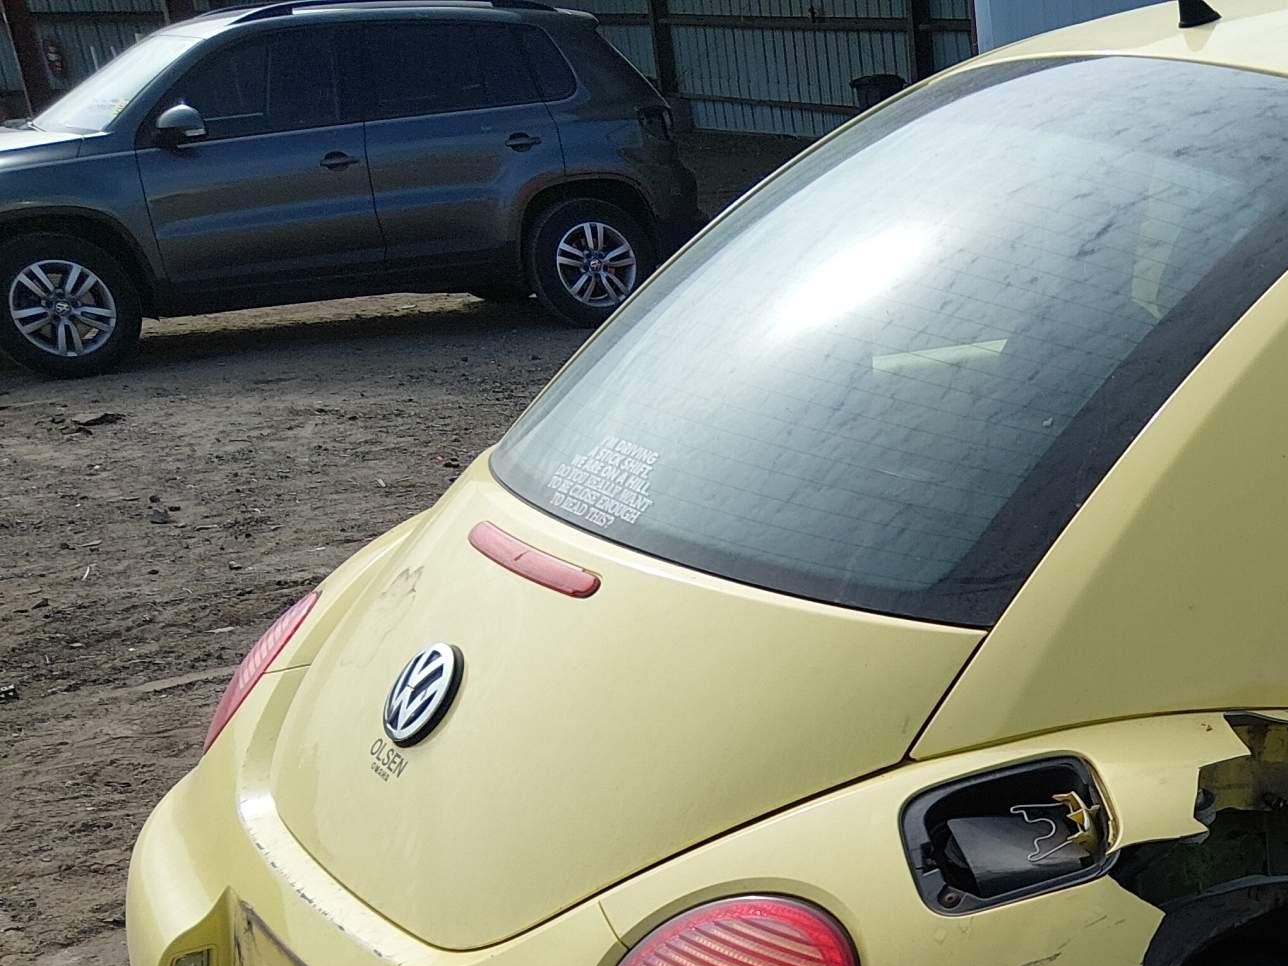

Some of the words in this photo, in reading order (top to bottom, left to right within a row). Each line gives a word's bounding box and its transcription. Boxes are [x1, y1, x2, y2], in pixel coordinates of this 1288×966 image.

[595, 448, 625, 467] STICK
[615, 440, 658, 464] DRIVING
[554, 463, 571, 477] DO
[567, 469, 590, 484] YOU
[583, 474, 623, 498] REALLY
[619, 488, 653, 512] WANT
[582, 459, 604, 474] ARE
[600, 465, 620, 481] ON
[615, 471, 628, 485] A
[547, 475, 562, 489] TO
[558, 480, 574, 494] BE
[569, 484, 601, 505] CLOSE
[595, 496, 641, 524] ENOUGH
[550, 491, 566, 506] TO
[560, 496, 588, 516] READ
[585, 507, 615, 529] THIS?
[370, 738, 409, 778] OLSEN
